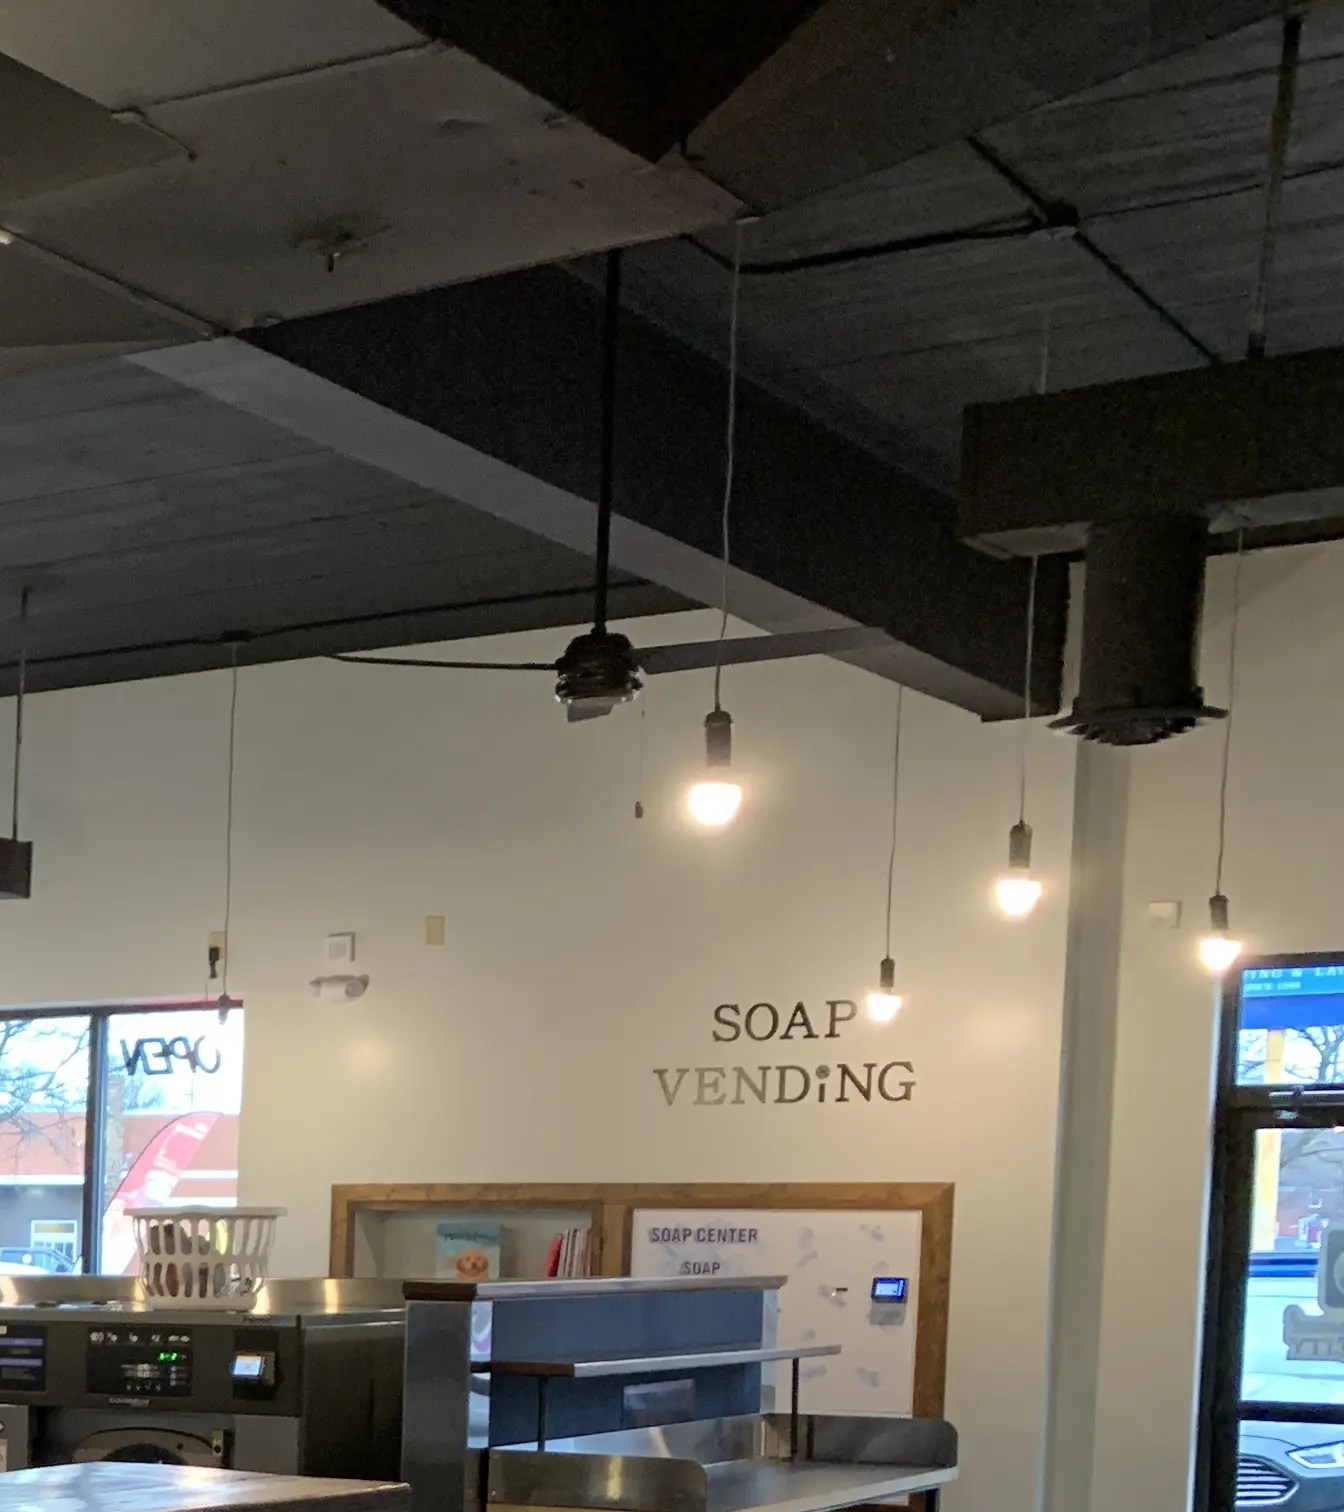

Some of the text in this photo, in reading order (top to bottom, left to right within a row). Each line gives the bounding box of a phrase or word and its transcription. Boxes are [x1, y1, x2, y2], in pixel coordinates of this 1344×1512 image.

[712, 999, 858, 1042] SOAP
[651, 1227, 758, 1243] SOAP CENTER
[682, 1261, 721, 1276] SOAP
